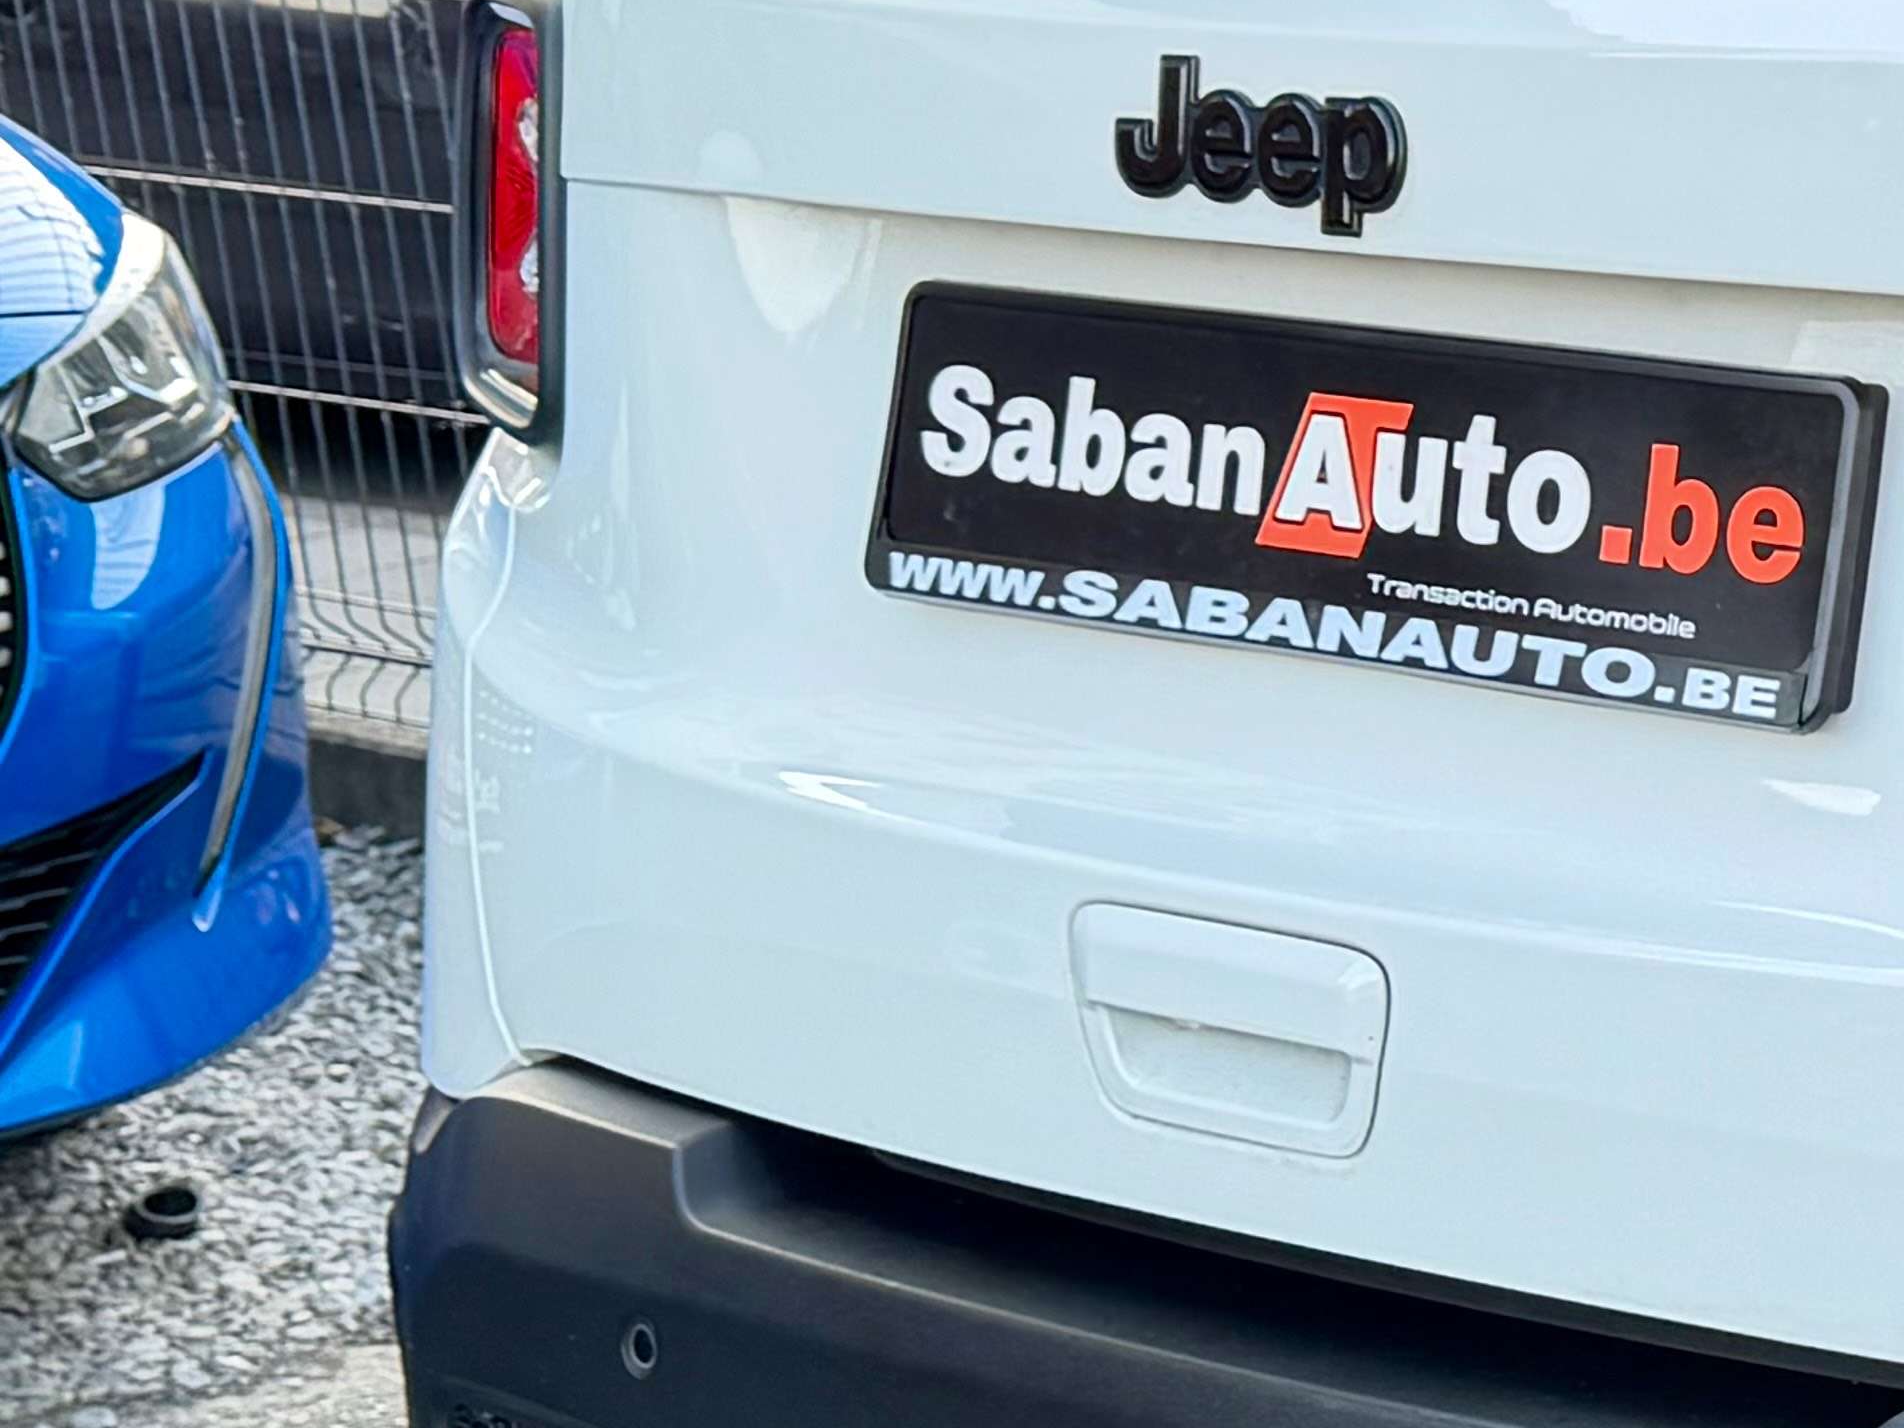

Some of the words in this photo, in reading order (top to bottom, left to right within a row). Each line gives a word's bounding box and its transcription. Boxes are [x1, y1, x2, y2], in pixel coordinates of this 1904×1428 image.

[1114, 53, 1409, 238] Jeep
[920, 364, 1806, 584] SabanAuto.be
[1367, 572, 1530, 618] Transaction
[1532, 598, 1698, 640] Automobile
